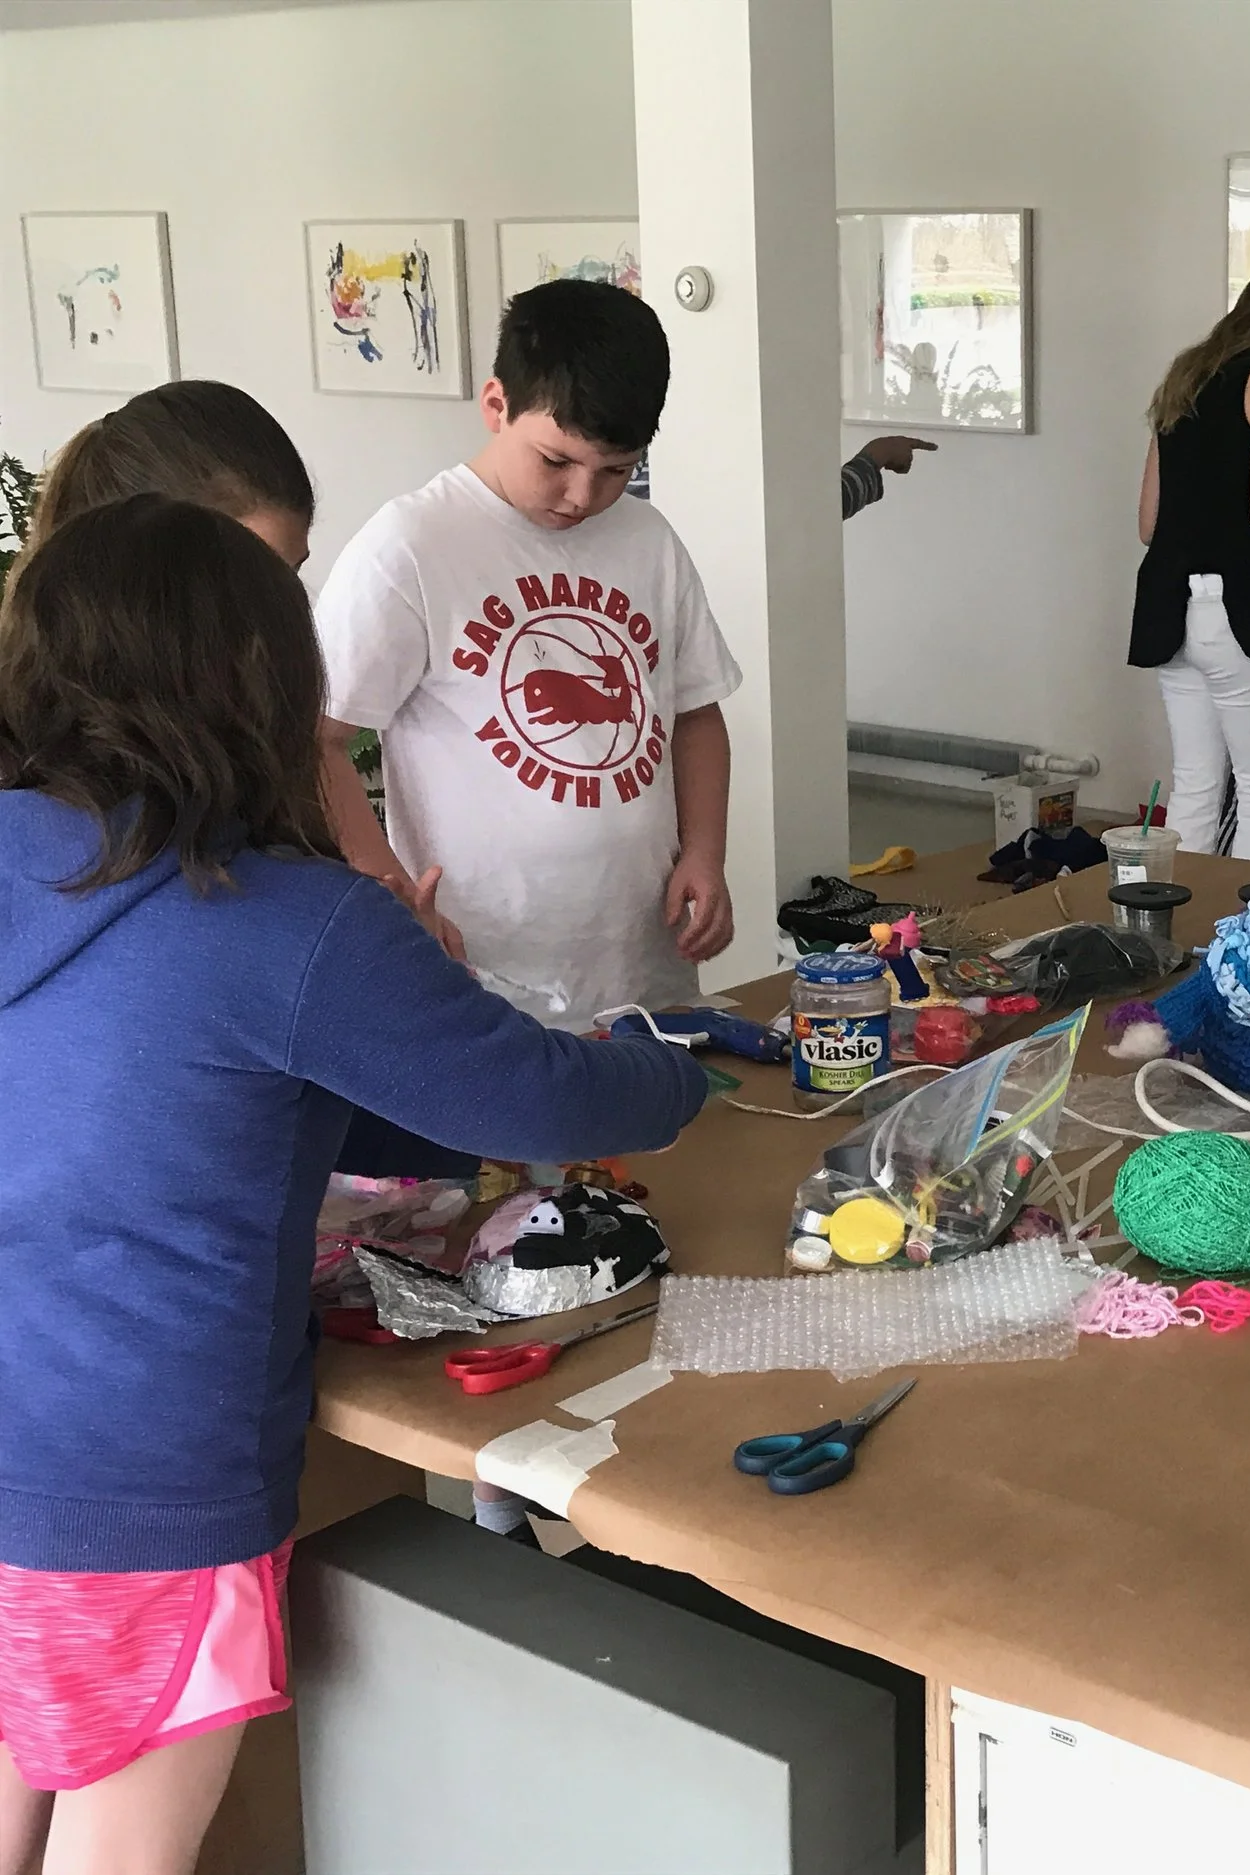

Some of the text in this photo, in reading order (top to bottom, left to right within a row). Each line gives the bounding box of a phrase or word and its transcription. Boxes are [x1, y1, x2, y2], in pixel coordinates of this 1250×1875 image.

[453, 595, 514, 677] SAG
[474, 715, 601, 808] YOUTH
[804, 1039, 878, 1061] vlasic
[819, 1070, 848, 1079] KOSHER
[829, 1078, 855, 1086] SPEARS
